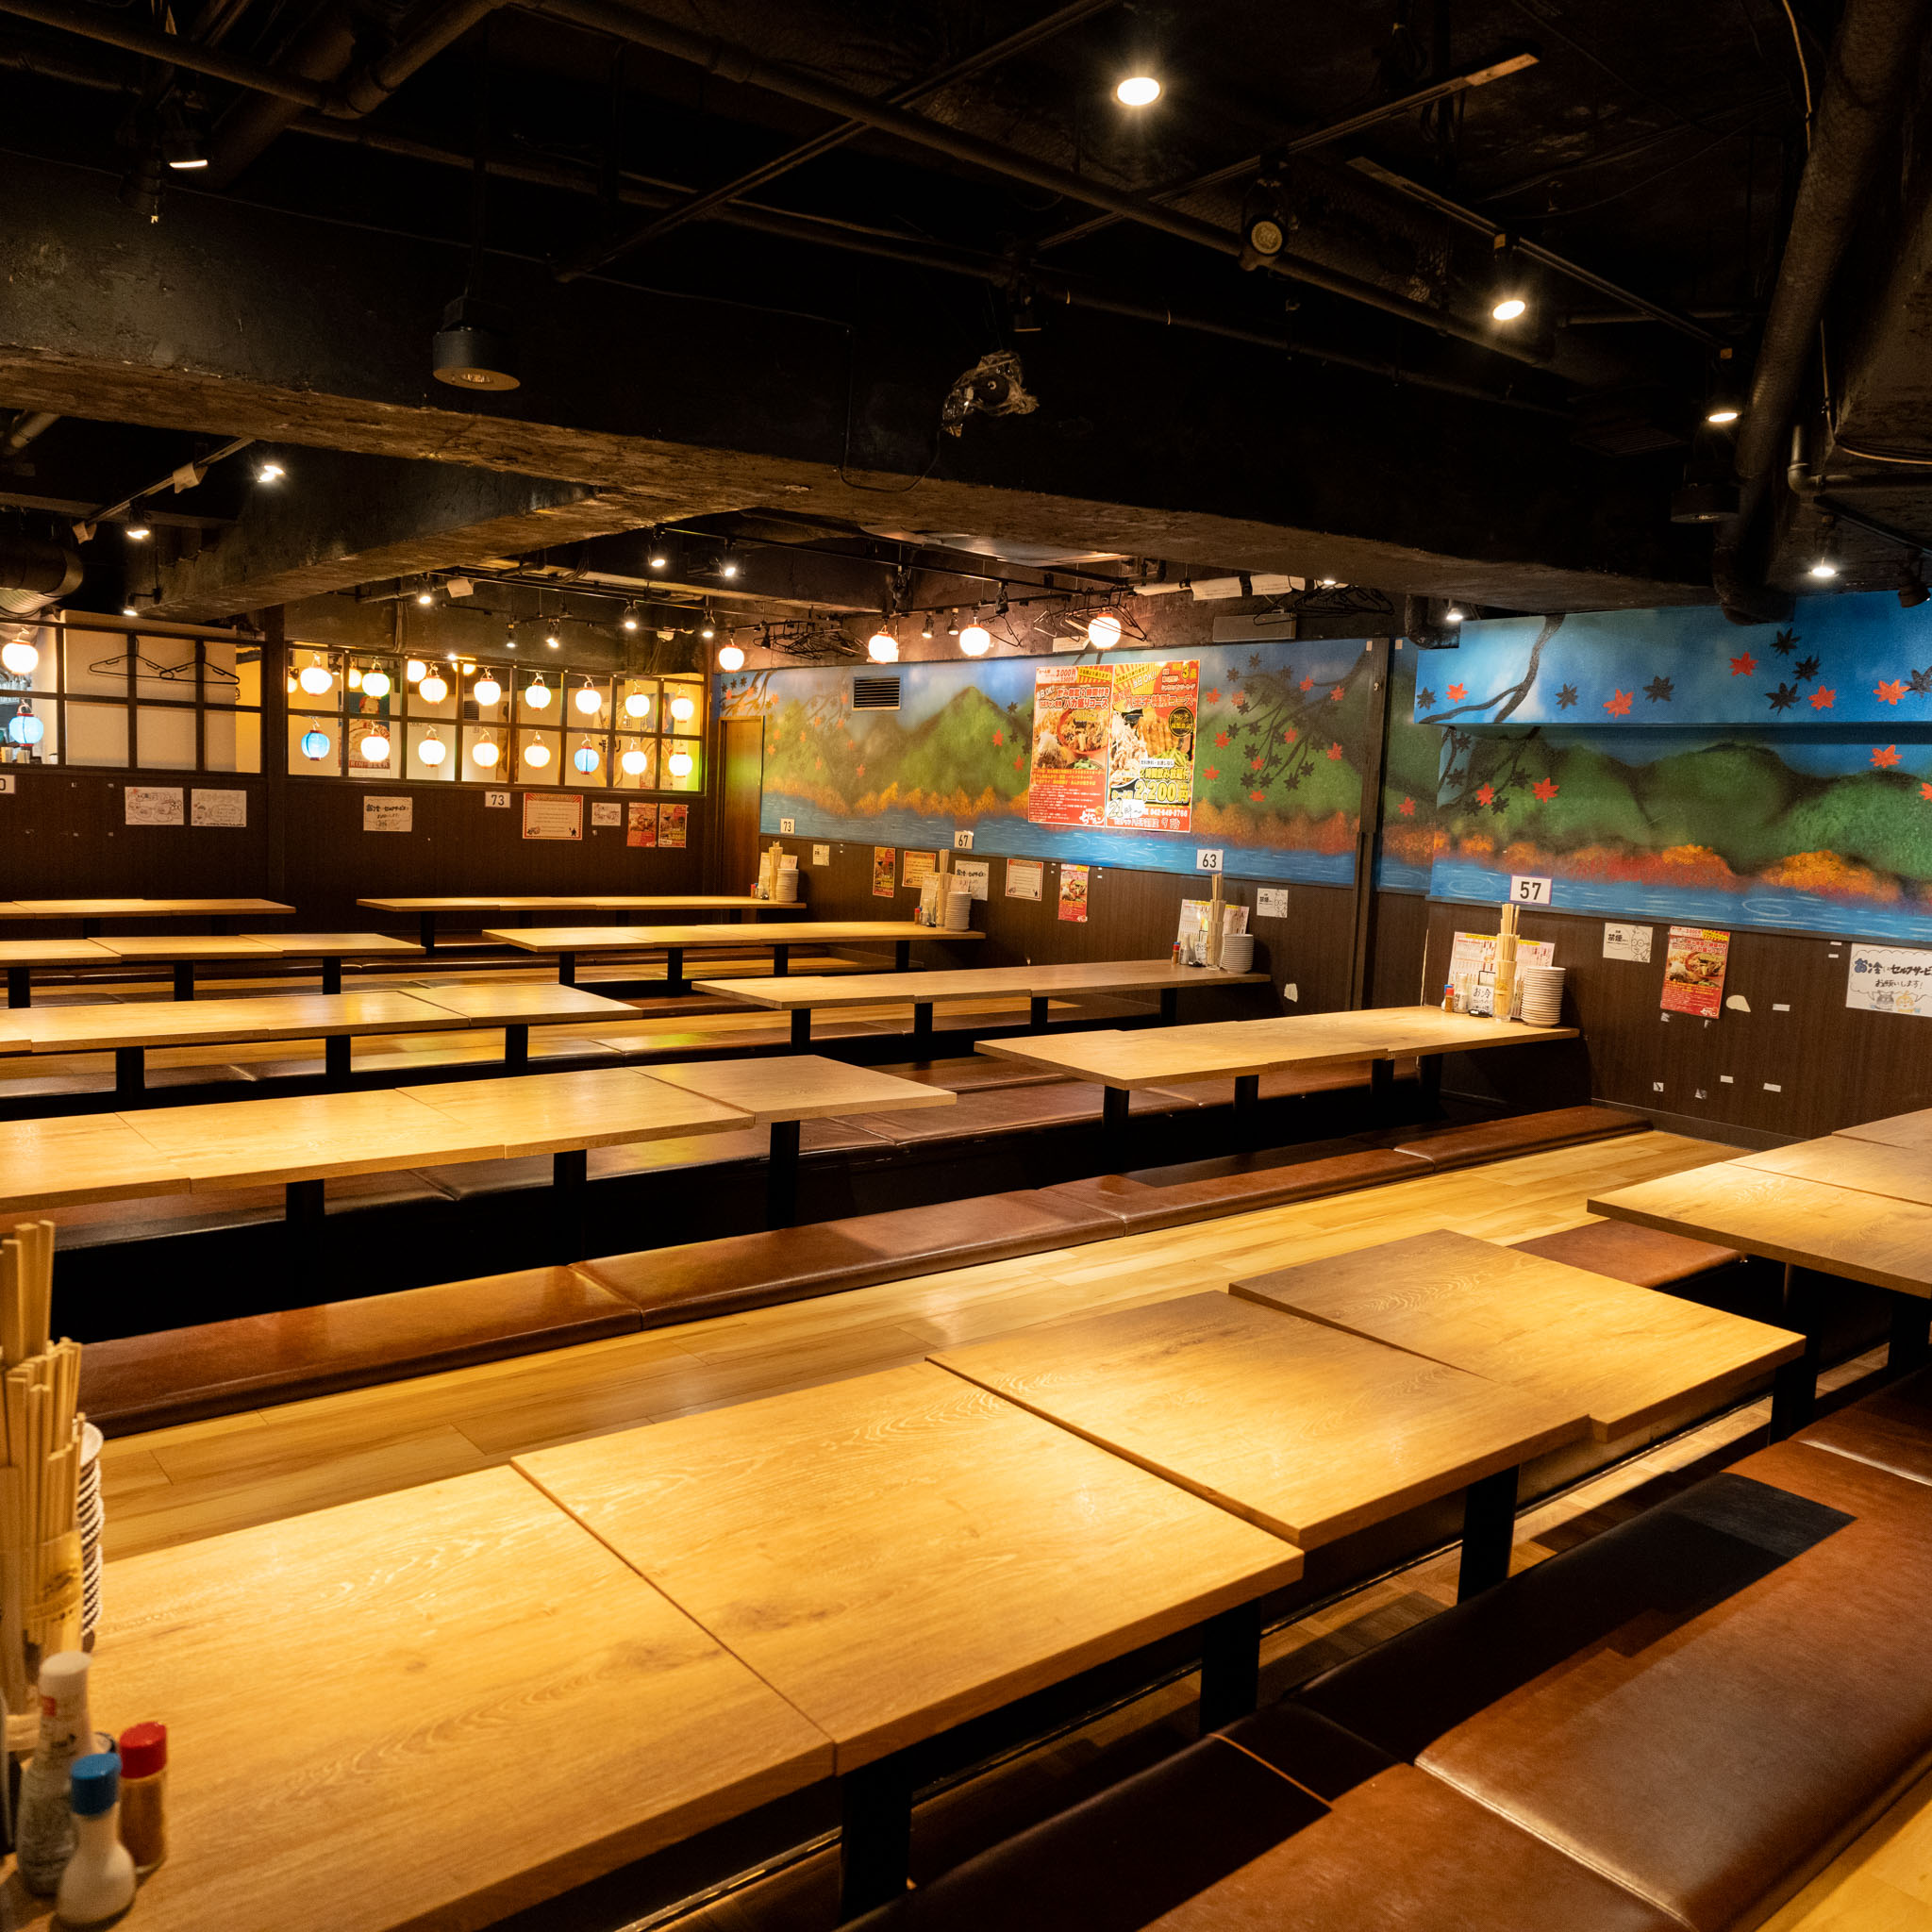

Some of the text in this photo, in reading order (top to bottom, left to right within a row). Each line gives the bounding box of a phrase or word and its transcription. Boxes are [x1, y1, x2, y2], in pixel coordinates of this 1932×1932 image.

[491, 794, 505, 806] 73
[783, 821, 791, 832] 73
[958, 835, 969, 847] 67
[1202, 853, 1217, 868] 63
[1520, 881, 1541, 900] 57
